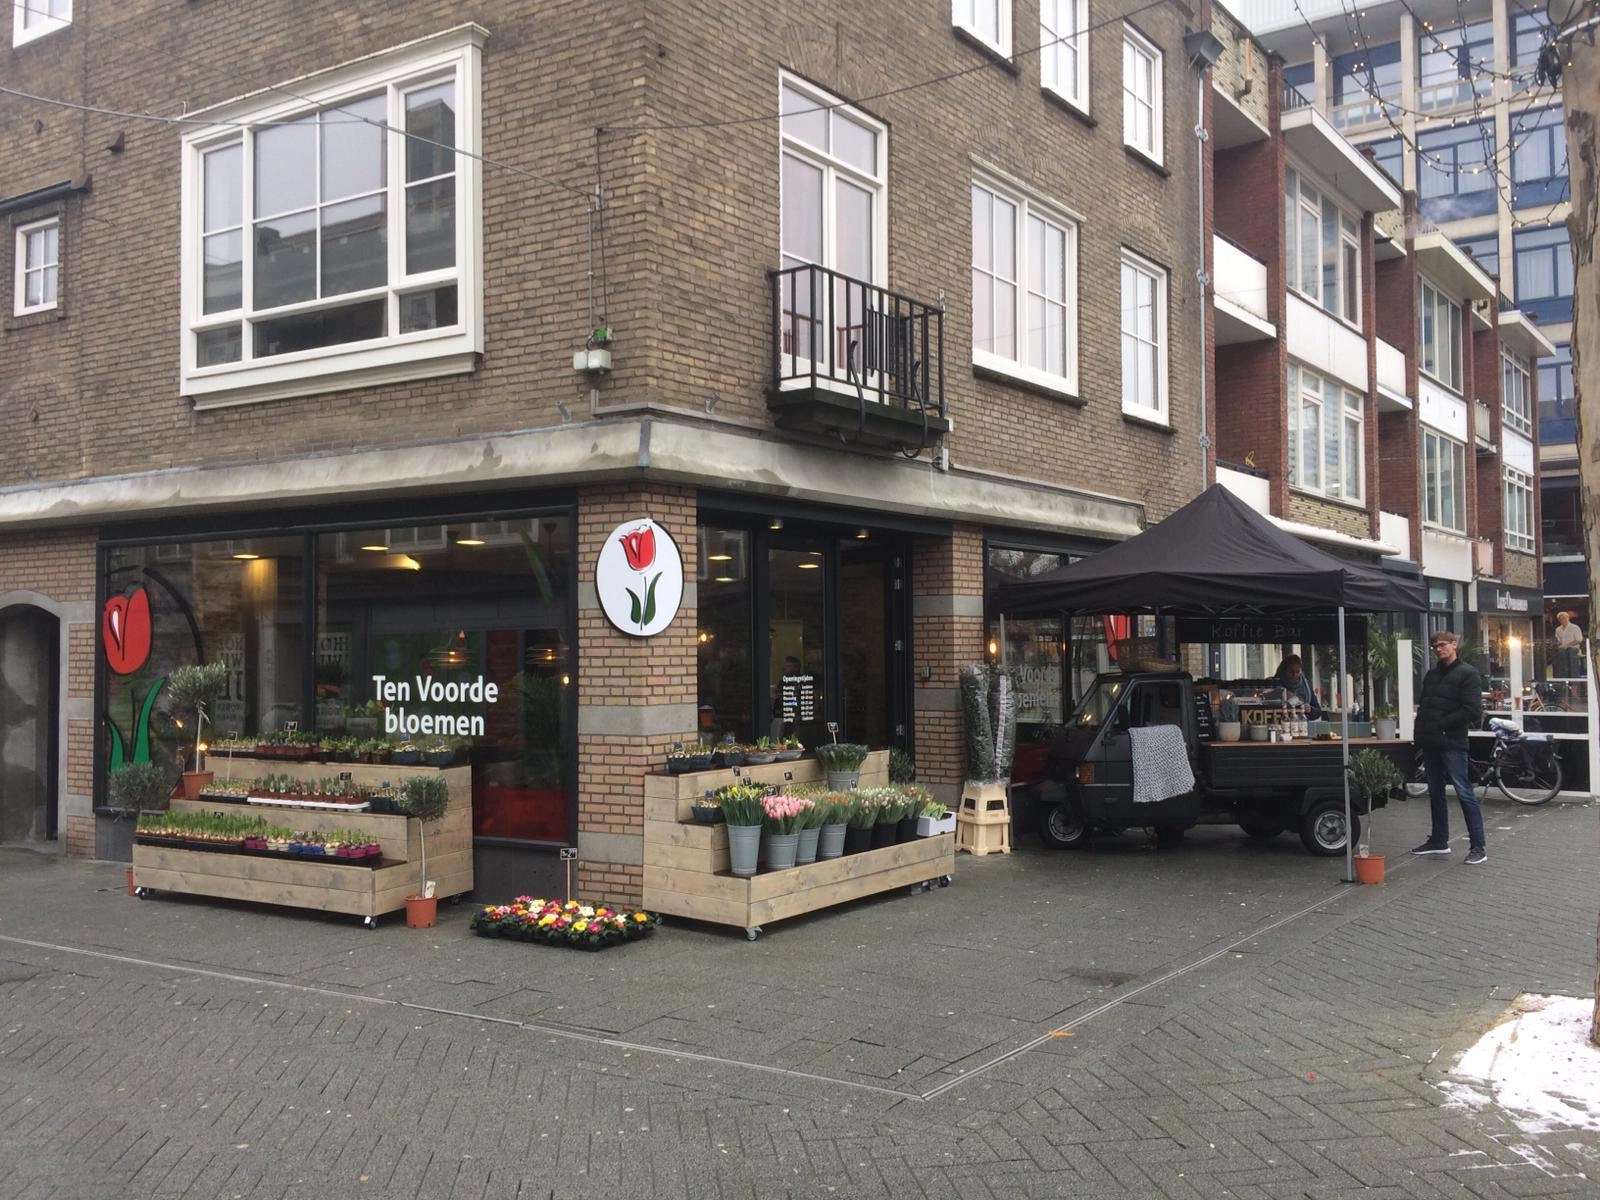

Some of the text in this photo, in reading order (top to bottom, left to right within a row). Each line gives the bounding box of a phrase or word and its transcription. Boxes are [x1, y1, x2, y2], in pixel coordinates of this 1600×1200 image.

[372, 675, 499, 703] Ten Voorde
[384, 706, 485, 736] bloemen
